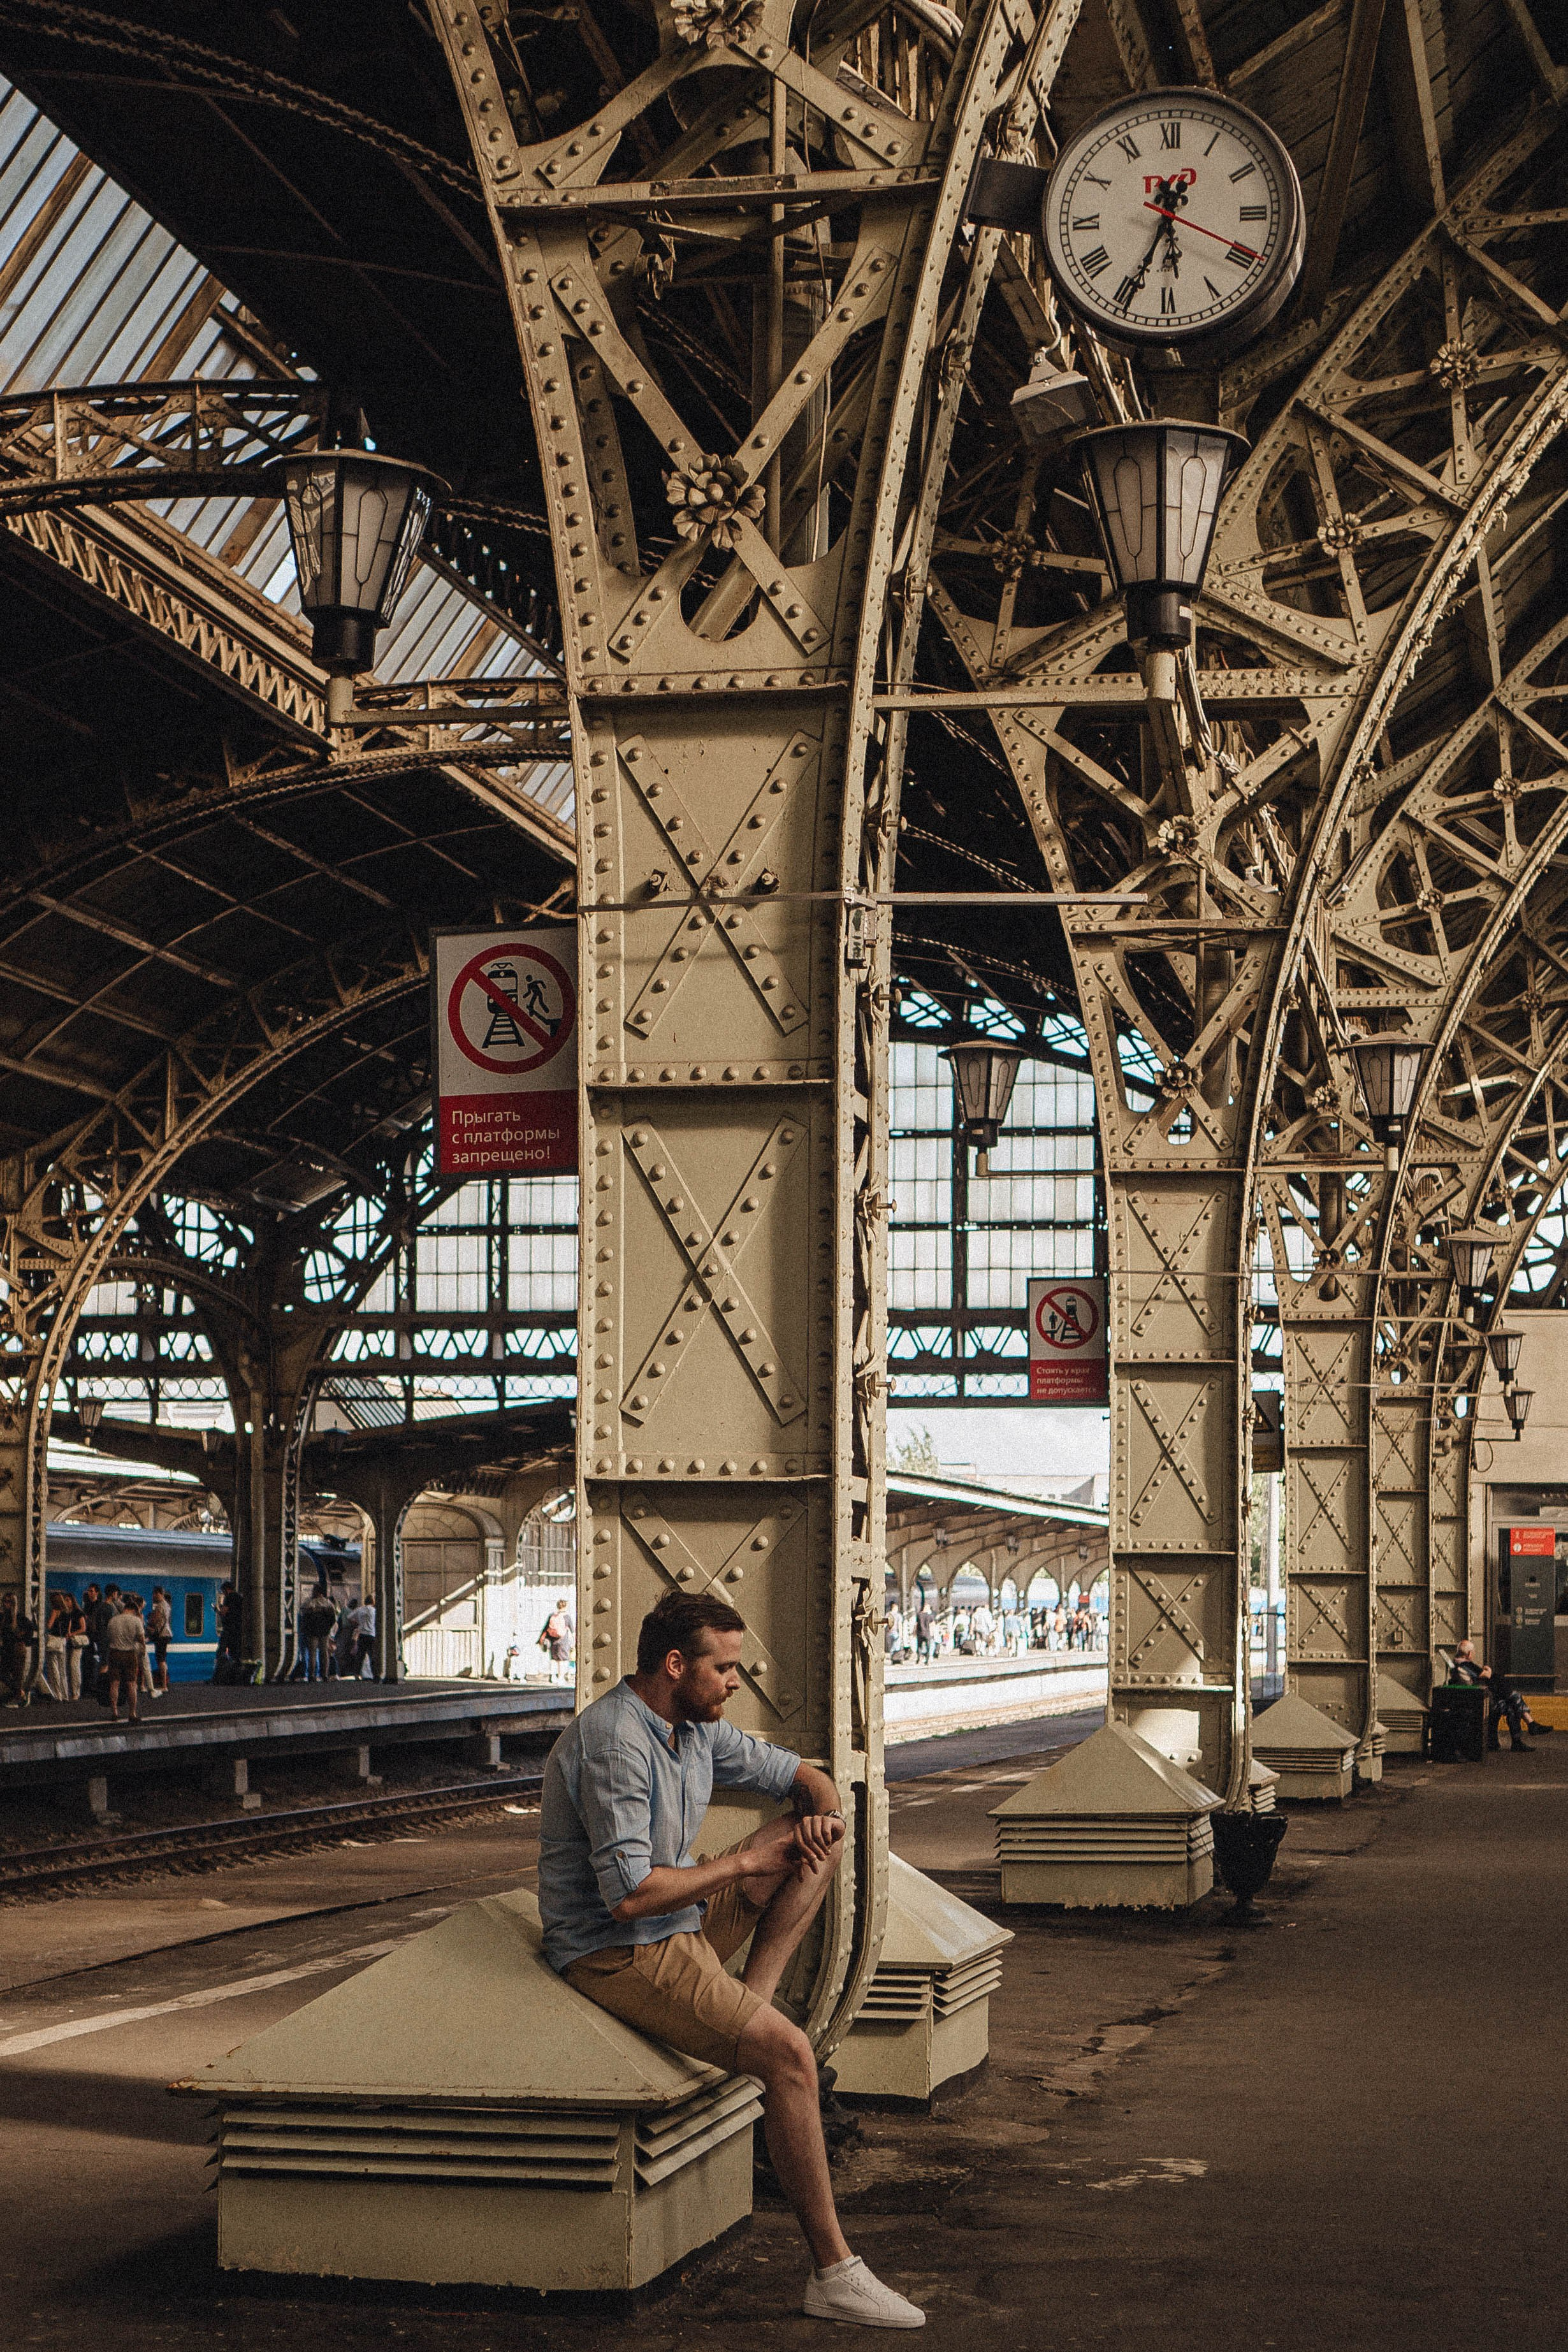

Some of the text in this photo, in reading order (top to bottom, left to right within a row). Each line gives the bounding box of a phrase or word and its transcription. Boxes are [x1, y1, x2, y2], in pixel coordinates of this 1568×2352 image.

[1160, 122, 1180, 150] XII
[1203, 131, 1221, 157] I
[1116, 133, 1142, 164] XI
[1084, 171, 1112, 191] X
[1229, 161, 1256, 184] II
[1073, 212, 1100, 231] IX
[1240, 205, 1267, 222] III
[1080, 245, 1112, 280] VIII
[1203, 275, 1221, 301] V
[1161, 287, 1176, 314] VI
[452, 1110, 521, 1127] Прыгать
[452, 1128, 560, 1145] с платформы
[452, 1146, 551, 1166] запрещено!
